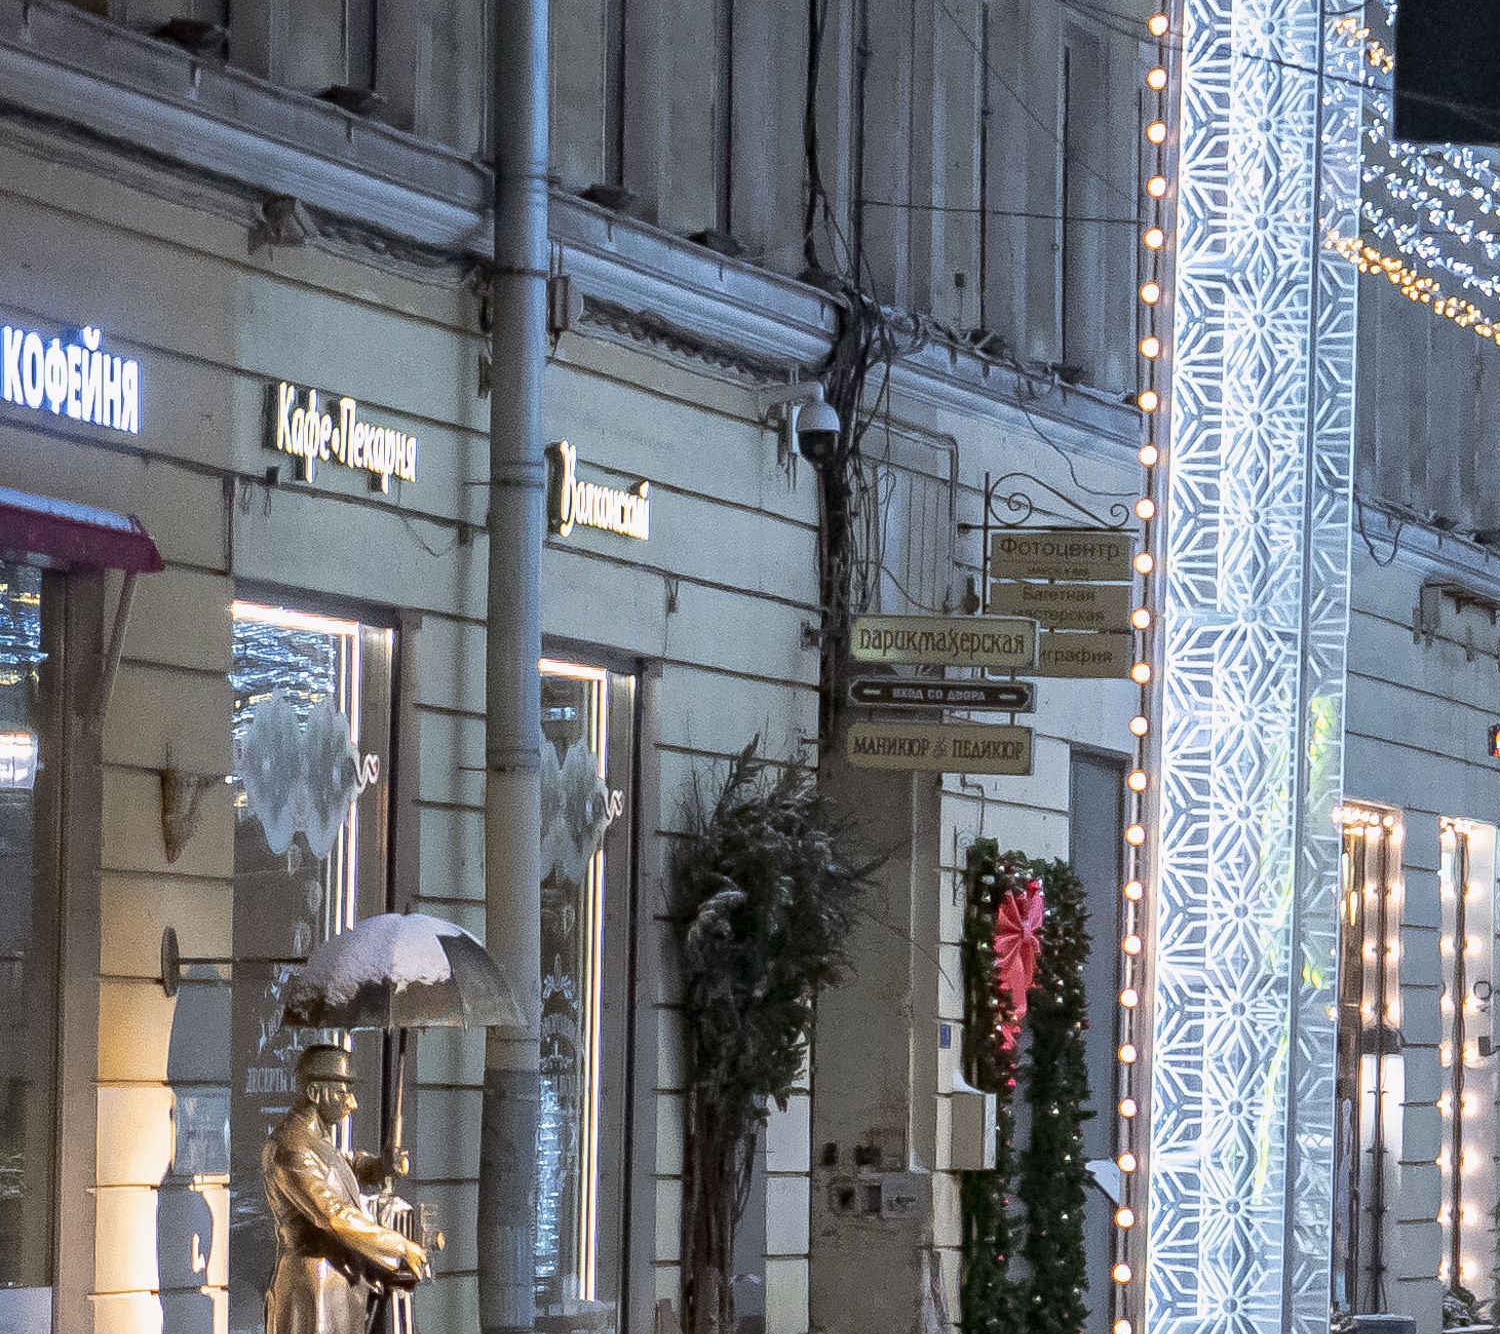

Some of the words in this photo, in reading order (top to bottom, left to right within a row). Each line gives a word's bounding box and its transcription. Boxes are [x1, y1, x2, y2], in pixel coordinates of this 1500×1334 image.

[2, 324, 140, 435] КОФЕЙНЯ
[559, 439, 652, 541] Волконский
[1000, 537, 1120, 561] Фотоцентр
[1021, 585, 1096, 601] Багетная
[859, 628, 1025, 660] парикмахерская
[892, 687, 924, 700] ВХОД
[927, 689, 944, 700] СО
[946, 689, 986, 701] ДВОРА
[853, 736, 930, 757] МАНИКЮР
[951, 739, 1025, 760] ПЕДИКЮР
